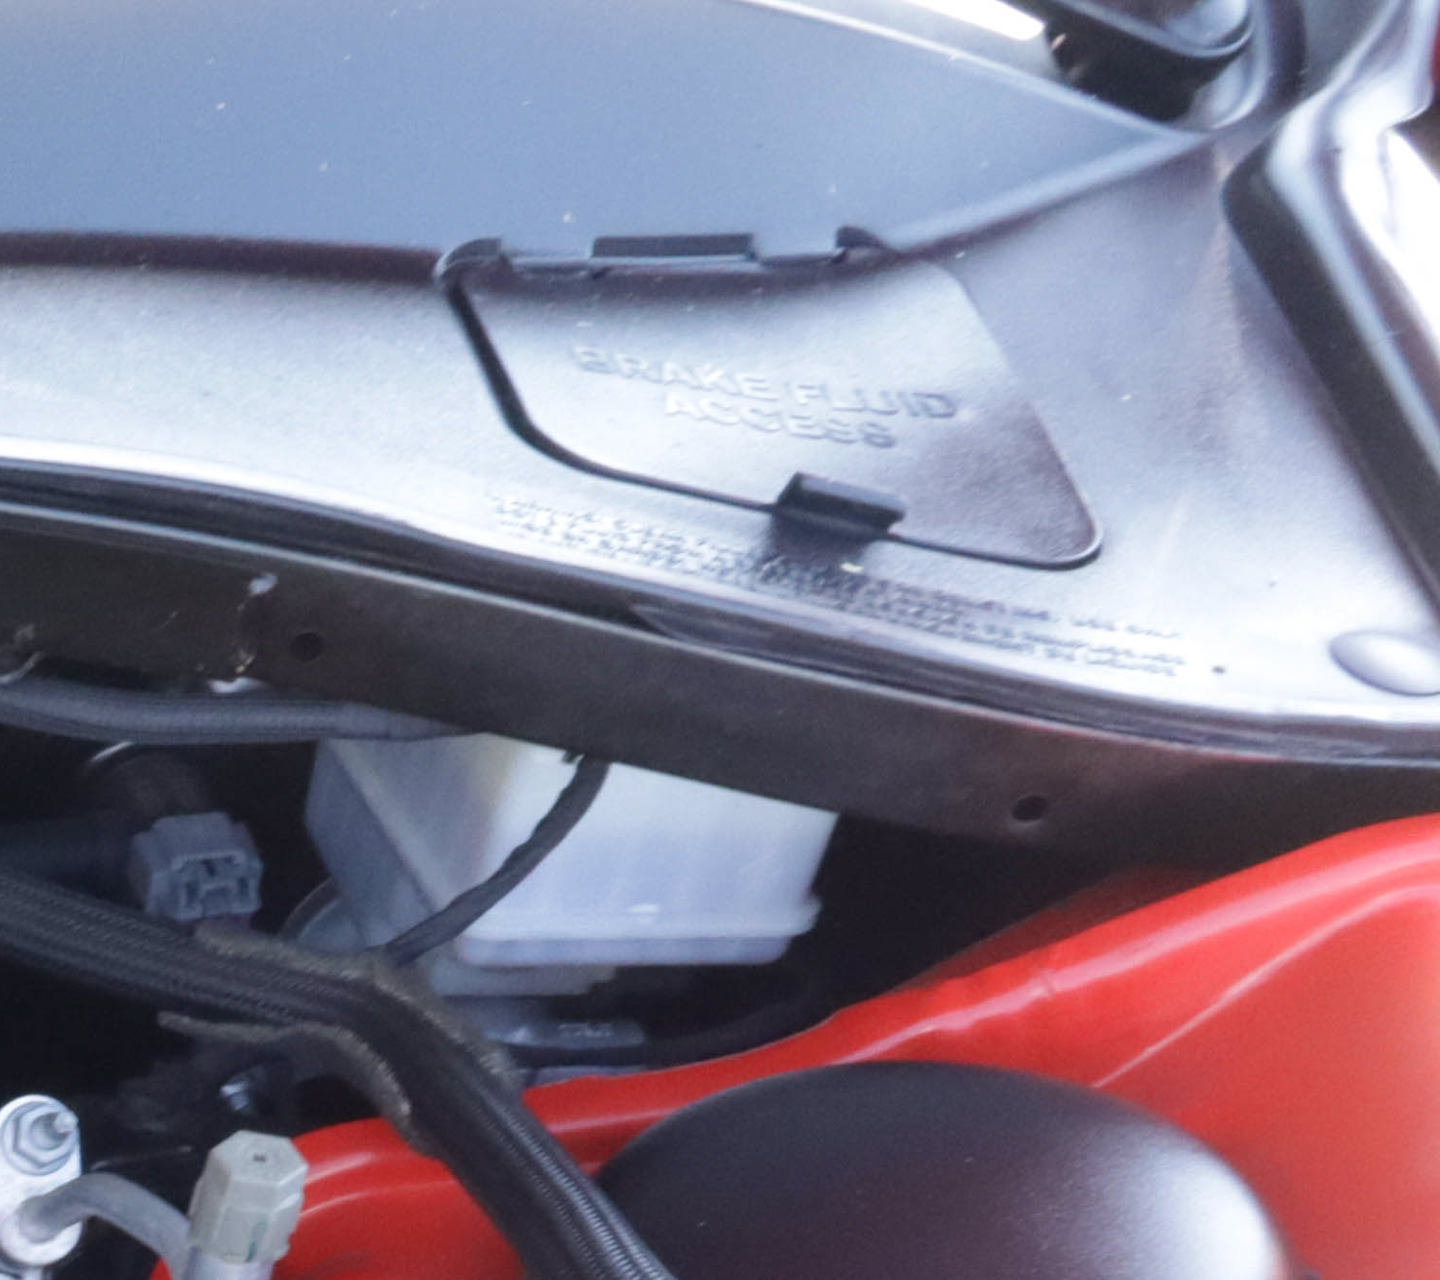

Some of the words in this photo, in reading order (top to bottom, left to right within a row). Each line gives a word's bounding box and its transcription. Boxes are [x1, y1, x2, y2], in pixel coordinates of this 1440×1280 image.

[574, 347, 775, 398] BRAKE
[796, 380, 957, 420] FLUID
[665, 391, 899, 449] ACCESS
